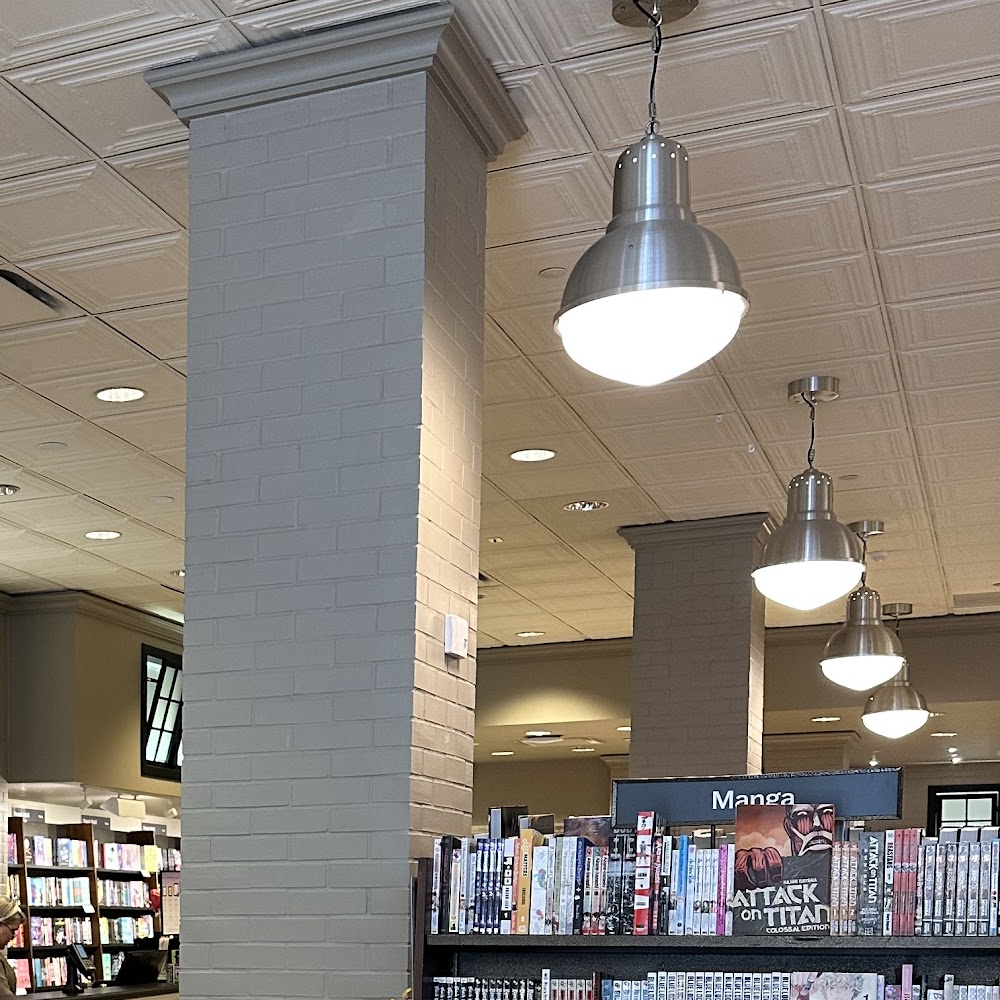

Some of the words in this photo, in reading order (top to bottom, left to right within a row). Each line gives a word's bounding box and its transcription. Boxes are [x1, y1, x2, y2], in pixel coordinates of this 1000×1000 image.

[712, 790, 794, 810] Manga
[728, 882, 820, 908] ATTACK
[868, 878, 878, 903] TITAN
[741, 908, 762, 920] on
[764, 904, 830, 926] TITAN
[766, 926, 800, 934] COLOSSAL
[802, 924, 830, 932] EDITION
